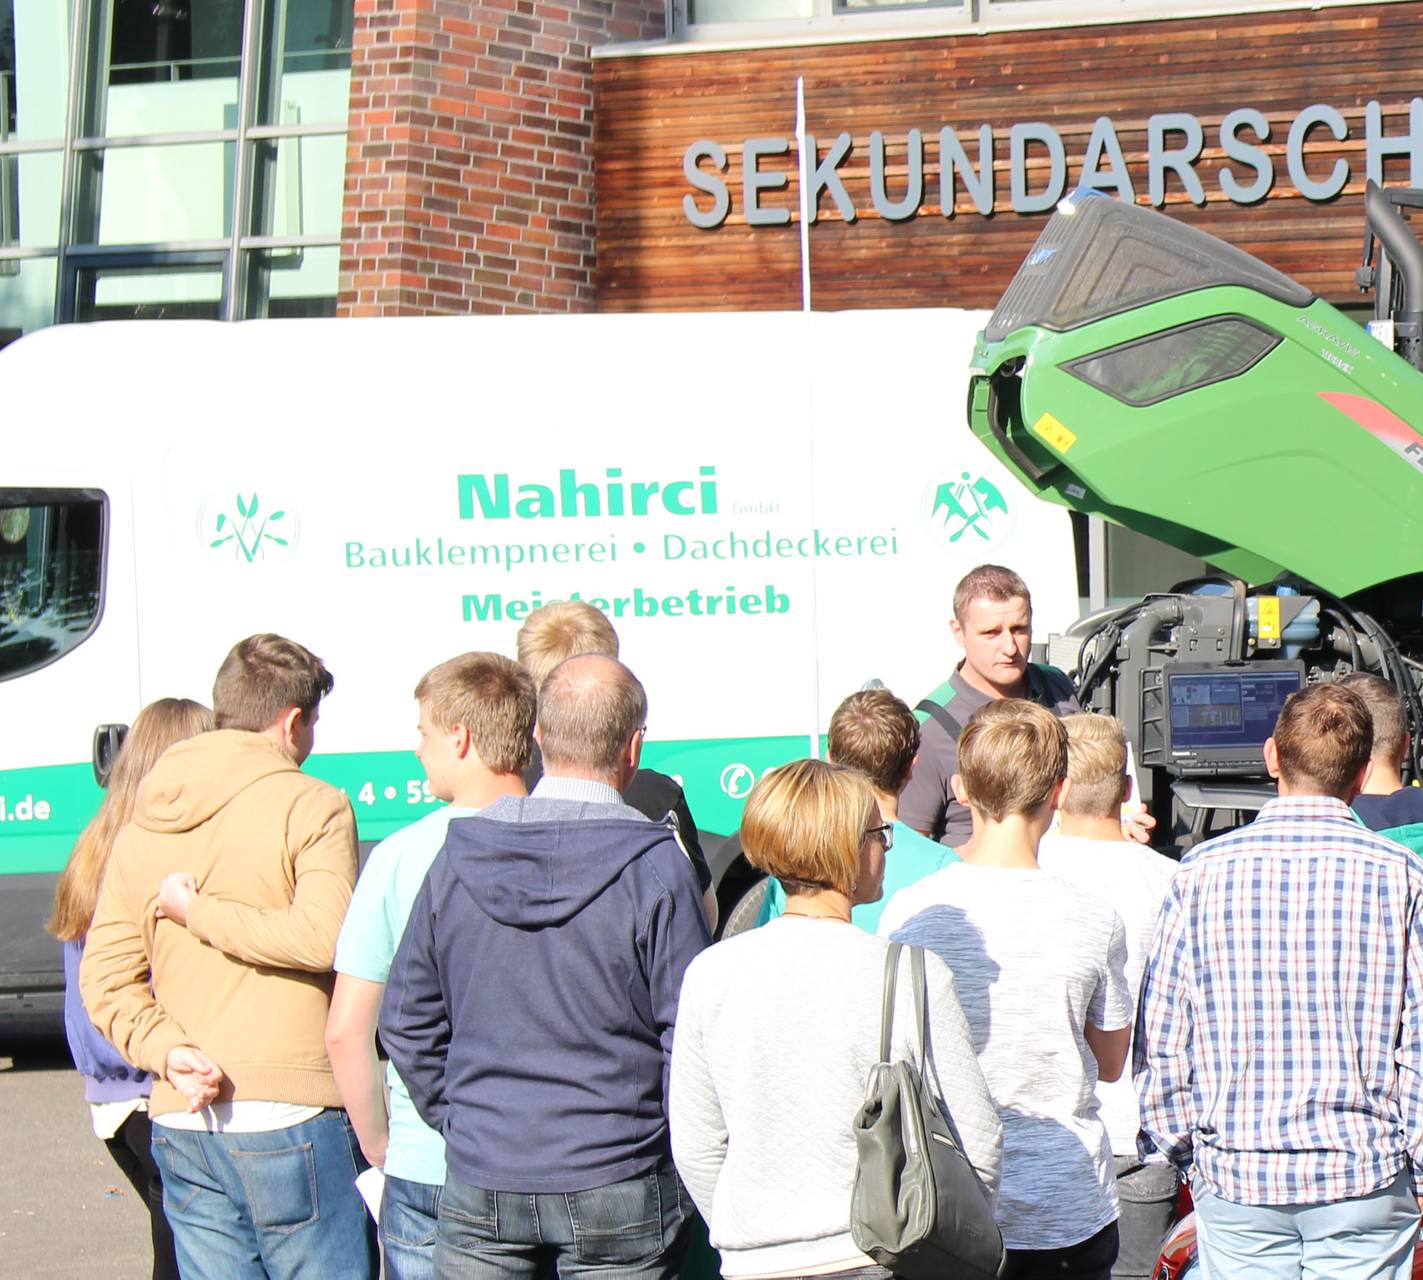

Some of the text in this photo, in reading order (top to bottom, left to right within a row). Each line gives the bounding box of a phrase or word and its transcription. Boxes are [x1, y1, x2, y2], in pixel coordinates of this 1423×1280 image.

[456, 466, 718, 520] Nahirci
[345, 527, 898, 572] Bauklempnerei Dachdeckerei
[461, 584, 791, 622] Meierbetrieb
[358, 781, 376, 806] 4
